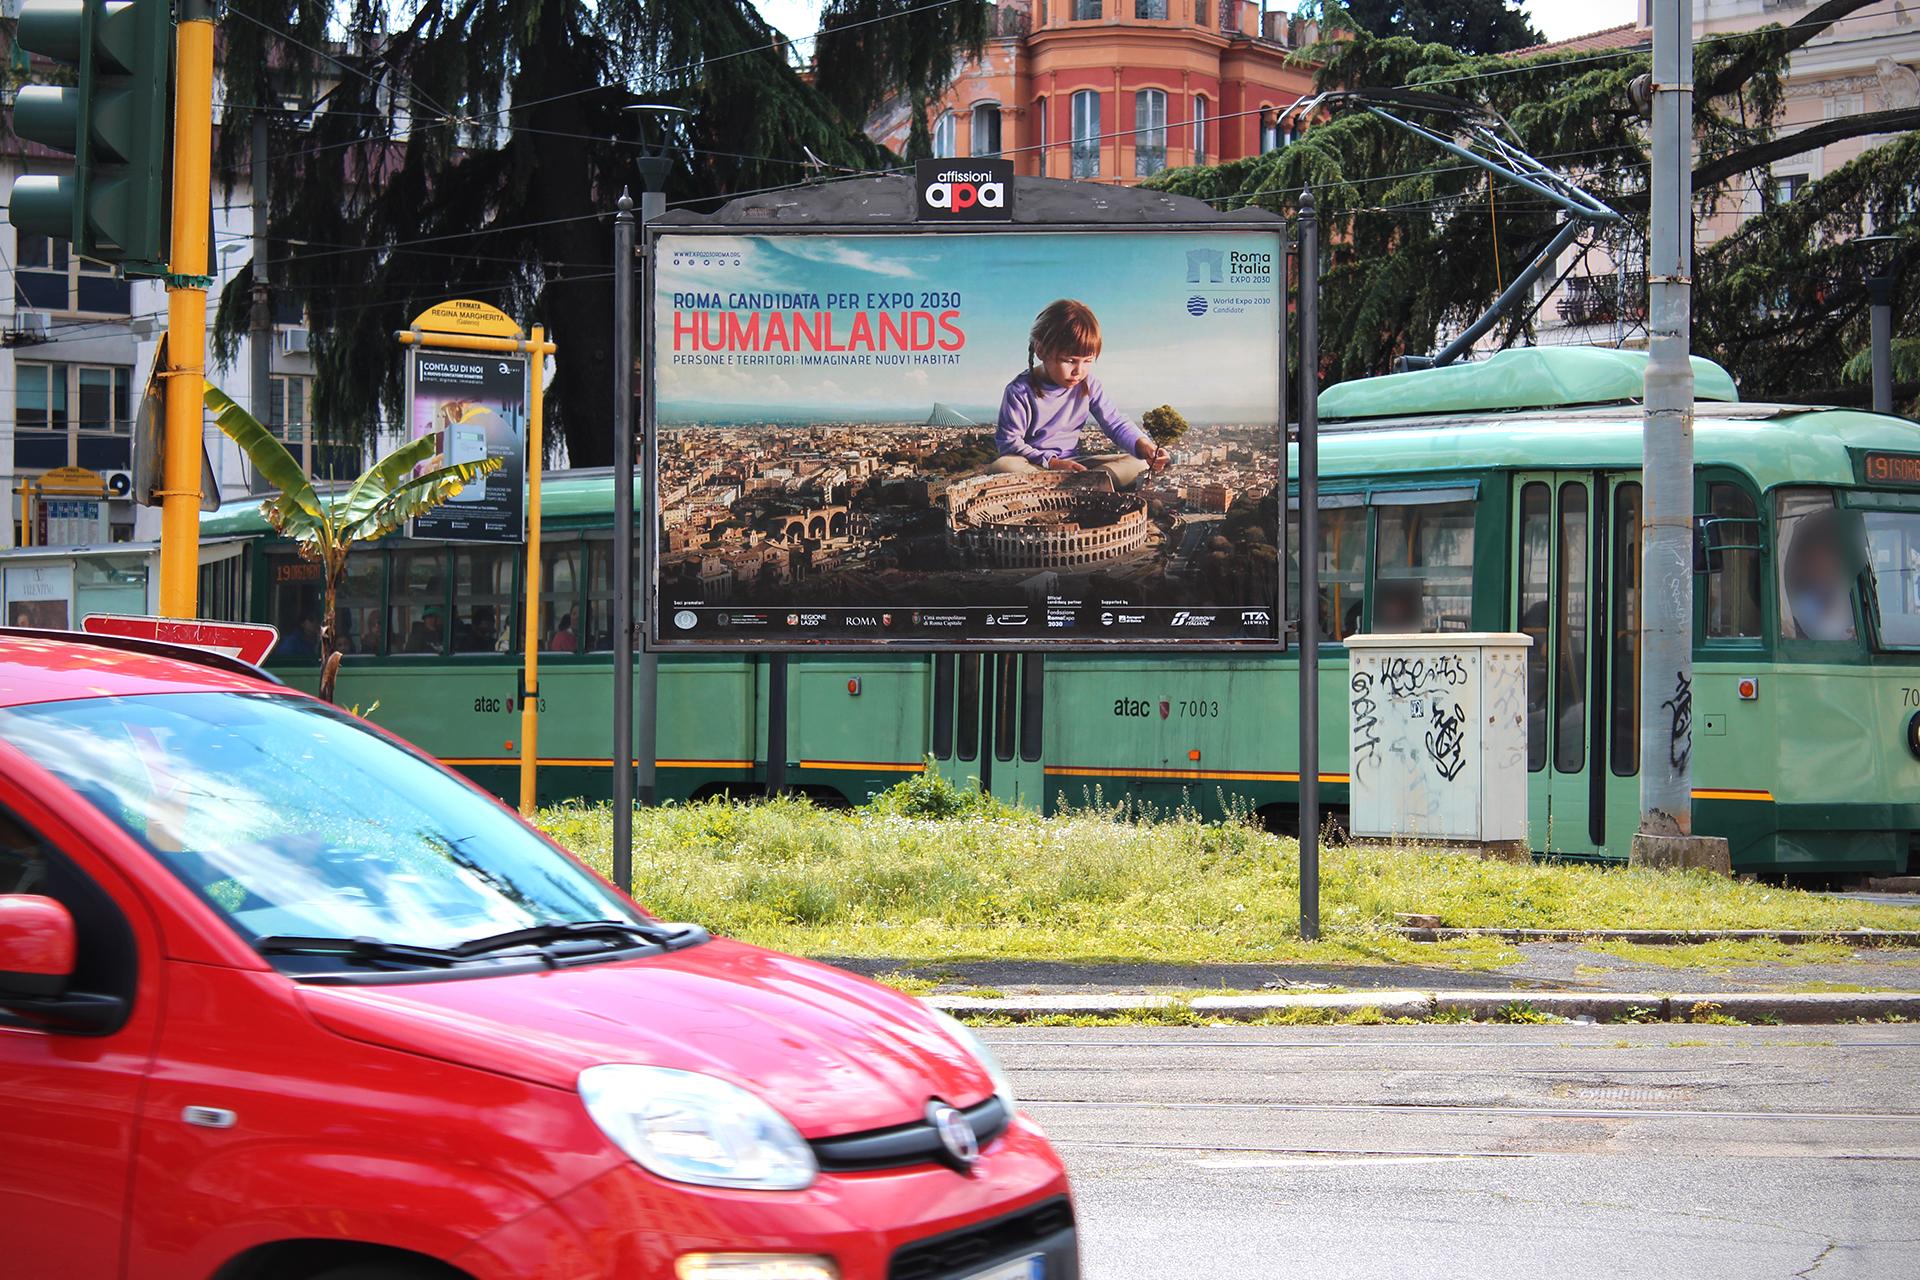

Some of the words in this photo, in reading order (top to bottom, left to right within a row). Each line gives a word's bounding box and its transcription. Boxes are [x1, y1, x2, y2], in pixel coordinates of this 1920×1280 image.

[937, 170, 992, 183] affissioni
[925, 182, 1004, 214] apa
[1230, 251, 1271, 263] Roma
[1230, 263, 1270, 275] Italia
[1230, 276, 1251, 284] EXPO
[1253, 276, 1271, 284] 2030
[455, 301, 481, 310] FERMATA
[674, 292, 722, 309] ROMA
[728, 293, 820, 310] CANDIDATA
[827, 293, 859, 309] PER
[867, 293, 914, 309] EXPO
[920, 292, 961, 309] 2030
[1235, 298, 1253, 306] Expo
[431, 309, 458, 318] REGINA
[459, 311, 505, 322] MARGHERITA
[673, 310, 966, 352] HUMANLANDS
[673, 354, 725, 365] PERSONE
[728, 355, 733, 365] E
[800, 355, 871, 366] IMMAGINARE
[875, 355, 911, 365] NUOVI
[914, 354, 961, 365] HABITAT
[423, 362, 449, 372] CONTA
[449, 364, 459, 373] SU
[460, 365, 469, 373] DI
[469, 366, 484, 374] NOI
[1866, 456, 1888, 479] 19
[846, 617, 877, 626] ROMA
[1241, 612, 1270, 620] ITA
[474, 695, 500, 713] atac
[1114, 697, 1151, 717] atac
[1179, 700, 1219, 718] 7003
